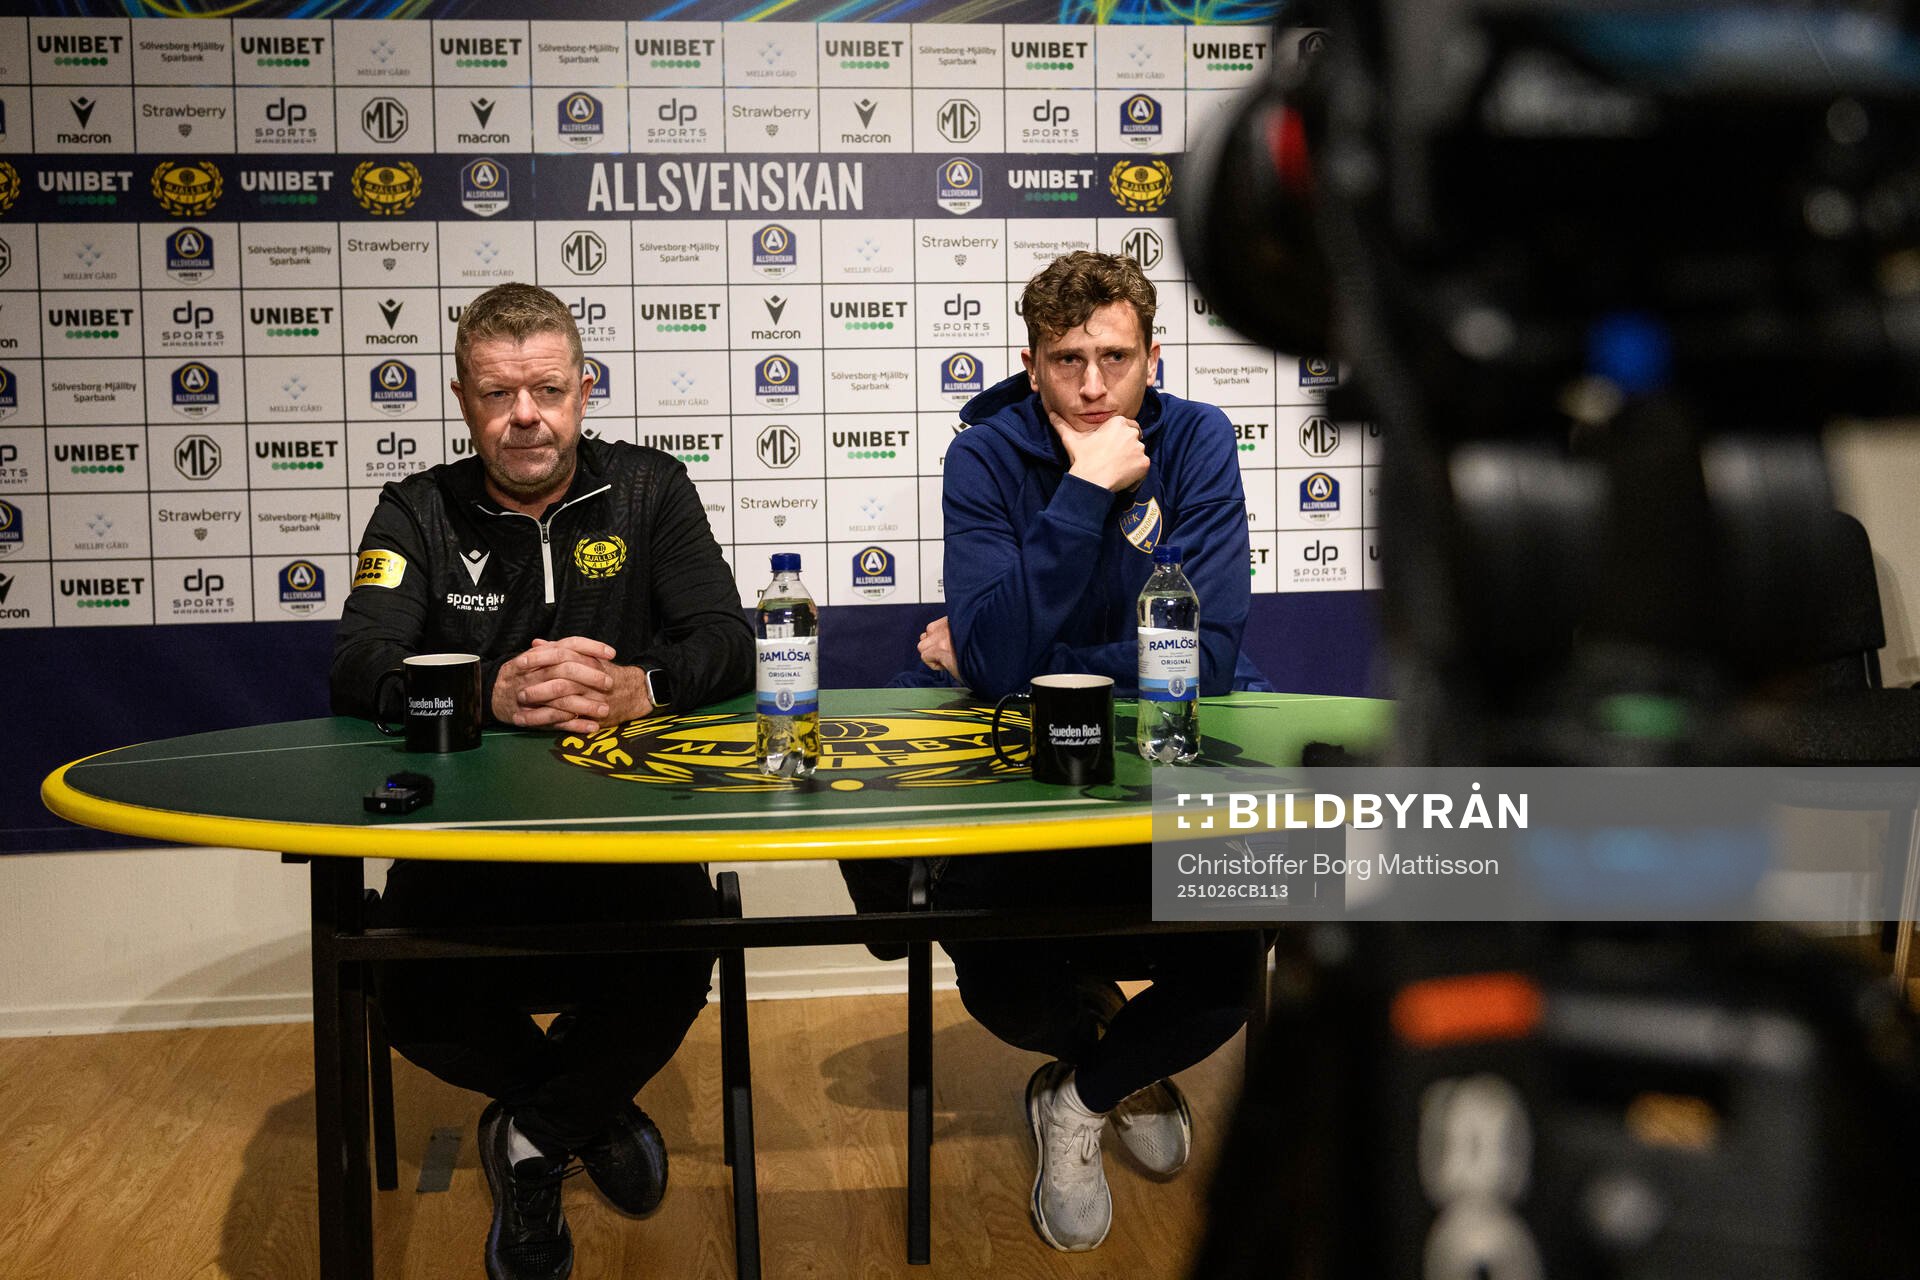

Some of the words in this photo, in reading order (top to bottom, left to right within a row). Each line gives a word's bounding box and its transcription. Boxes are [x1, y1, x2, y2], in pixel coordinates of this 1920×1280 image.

[37, 35, 123, 54] UNIBET
[139, 40, 225, 54] Sölvesborg-Mjällby
[240, 36, 325, 56] UNIBET
[440, 38, 522, 55] UNIBET
[538, 43, 619, 55] Sölvesborg-Mjällby
[635, 39, 715, 56] UNIBET
[825, 40, 904, 57] UNIBET
[919, 45, 997, 57] Sölvesborg-Mjällby
[1011, 42, 1088, 59] UNIBET
[161, 52, 203, 64] Sparbank
[1193, 43, 1267, 60] UNIBET
[558, 54, 599, 65] Sparbank
[938, 56, 977, 66] Sparbank
[357, 68, 385, 76] MELLBY
[746, 70, 772, 78] MELLBY
[142, 104, 227, 120] Strawberry
[266, 96, 307, 126] dp
[658, 97, 697, 126] dp
[732, 105, 811, 120] Strawberry
[1033, 99, 1069, 127] dp
[365, 100, 406, 141] MG
[939, 101, 979, 141] MG
[254, 128, 317, 138] SPORTS
[561, 123, 600, 132] ALLSVENSKAN
[647, 128, 707, 137] SPORTS
[1022, 129, 1080, 137] SPORTS
[1123, 124, 1160, 133] ALLSVENSKAN
[57, 132, 112, 145] macron
[458, 132, 510, 144] macron
[841, 132, 891, 144] macron
[38, 170, 134, 192] UNIBET
[240, 171, 334, 191] UNIBET
[1008, 169, 1093, 189] UNIBET
[587, 161, 863, 211] ALLSVENSKAN
[466, 190, 505, 198] ALLSVENSKAN
[941, 188, 978, 198] ALLSVENSKAN
[347, 239, 430, 253] Strawberry
[639, 241, 720, 254] Sölvesborg-Mjällby
[921, 235, 999, 249] Strawberry
[1014, 240, 1090, 251] Sölvesborg-Mjällby
[248, 244, 332, 257] Sölvesborg-Mjällby
[565, 234, 604, 272] MG
[1122, 229, 1162, 269] MG
[170, 258, 210, 268] ALLSVENSKAN
[269, 255, 311, 267] Sparbank
[659, 252, 700, 264] Sparbank
[756, 254, 794, 264] ALLSVENSKAN
[63, 272, 92, 280] MELLBY
[568, 296, 606, 325] dp
[641, 303, 721, 321] UNIBET
[830, 301, 908, 318] UNIBET
[944, 293, 981, 320] dp
[48, 309, 134, 327] UNIBET
[173, 300, 214, 329] dp
[250, 307, 334, 325] UNIBET
[578, 327, 616, 335] ORTS
[933, 323, 990, 331] SPORTS
[162, 331, 225, 340] SPORTS
[366, 333, 418, 345] macron
[751, 329, 800, 341] macron
[831, 371, 909, 383] Sölvesborg-Mjällby
[1194, 366, 1269, 376] Sölvesborg-Mjällby
[850, 381, 890, 392] Sparbank
[944, 382, 981, 391] ALLSVENSKAN
[1213, 376, 1250, 385] Sparbank
[52, 381, 137, 394] Sölvesborg-Mjällby
[758, 385, 796, 394] ALLSVENSKAN
[73, 392, 116, 404] Sparbank
[175, 393, 215, 402] ALLSVENSKAN
[374, 391, 413, 399] ALLSVENSKAN
[658, 398, 684, 406] MELLBY
[1233, 424, 1269, 439] BET
[1301, 417, 1338, 455] MG
[377, 431, 416, 459] dp
[644, 434, 724, 451] UNIBET
[832, 431, 910, 447] UNIBET
[54, 443, 140, 462] UNIBET
[255, 441, 338, 459] UNIBET
[759, 427, 799, 467] MG
[177, 437, 219, 478] MG
[366, 461, 427, 471] SPORTS
[740, 496, 818, 511] Strawberry
[1302, 502, 1337, 510] ALLSVENSKAN
[158, 509, 241, 524] Strawberry
[258, 512, 341, 524] Sölvesborg-Mjällby
[279, 523, 321, 534] Sparbank
[74, 542, 103, 550] MELLBY
[1304, 540, 1338, 565] dp
[61, 578, 145, 596] UNIBET
[184, 568, 224, 596] dp
[856, 575, 892, 586] ALLSVENSKAN
[283, 591, 322, 600] ALLSVENSKAN
[447, 593, 485, 607] sport
[173, 598, 235, 608] SPORTS
[0, 608, 30, 618] cron
[1149, 637, 1198, 652] RAMLÖSA
[759, 648, 811, 663] RAMLÖSA
[434, 697, 453, 709] Rock
[1049, 723, 1081, 737] Sweden
[662, 734, 993, 756] MJLLBY
